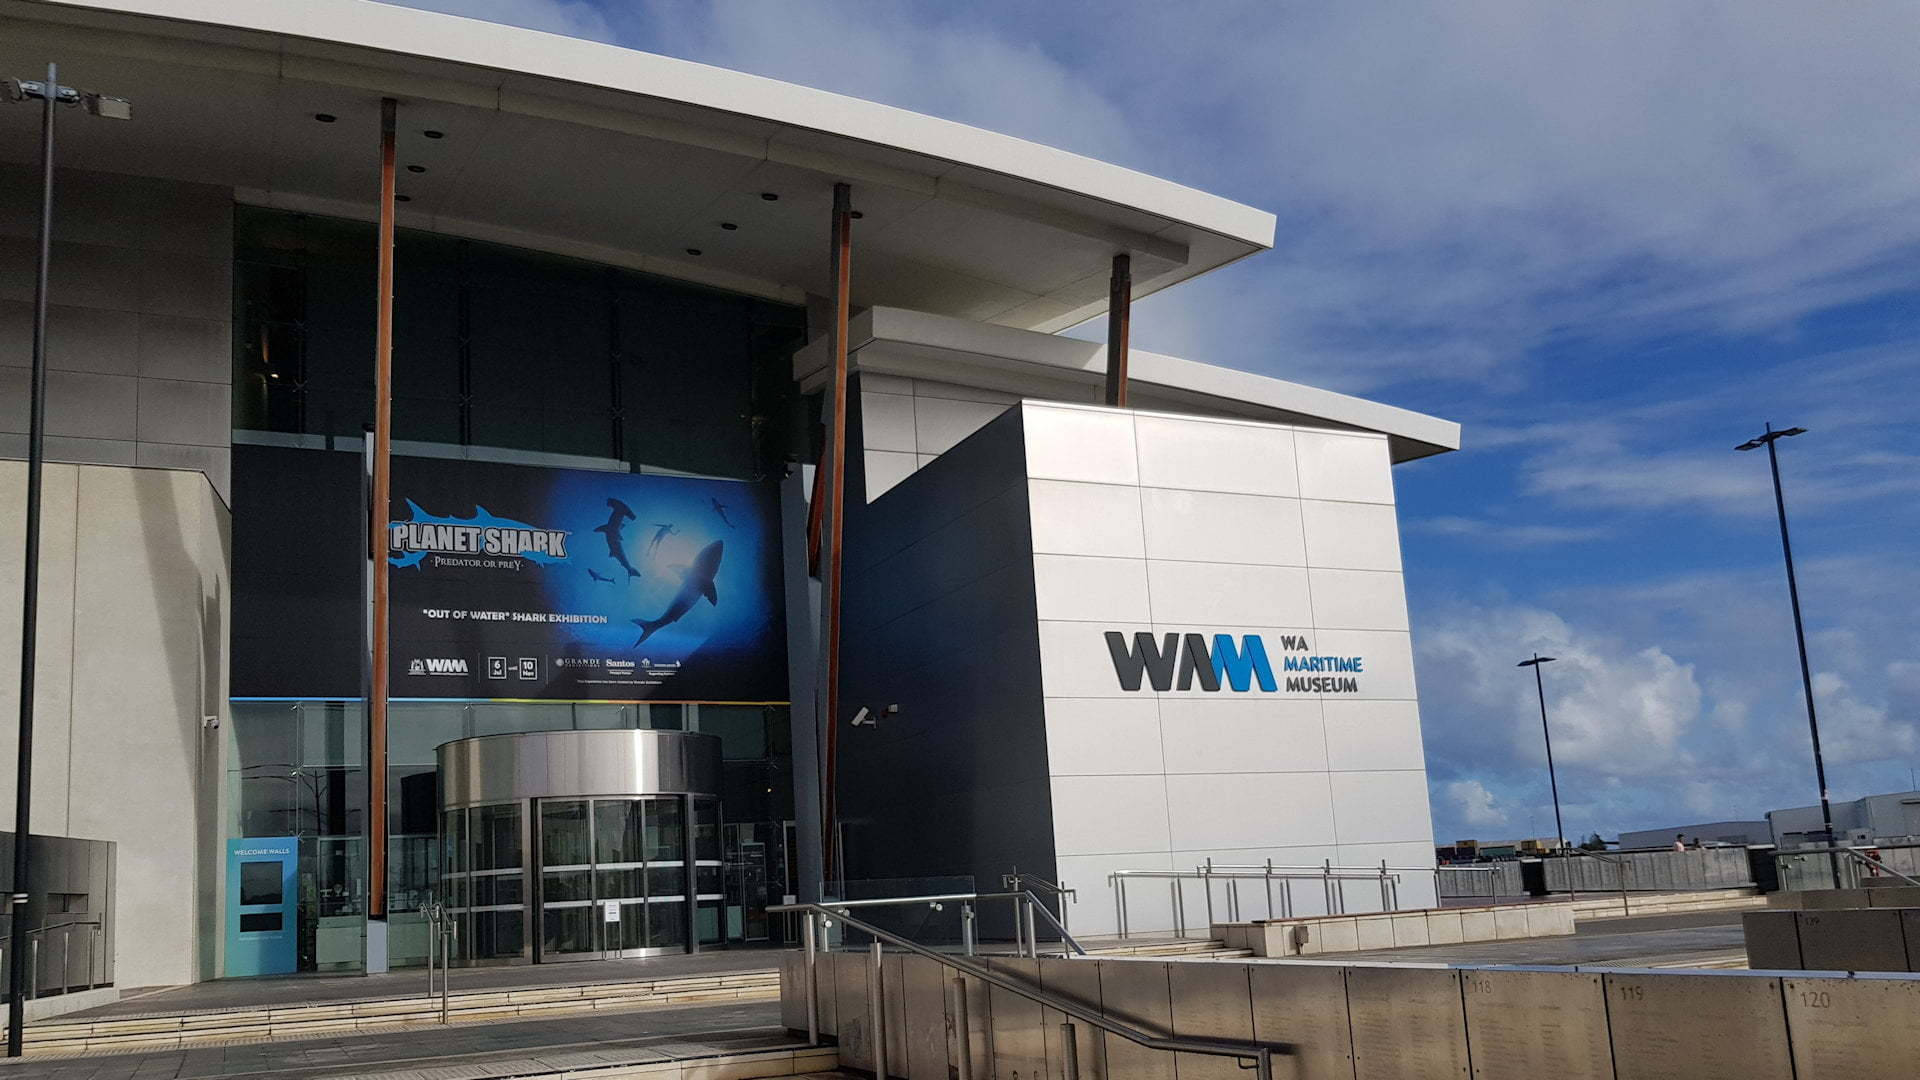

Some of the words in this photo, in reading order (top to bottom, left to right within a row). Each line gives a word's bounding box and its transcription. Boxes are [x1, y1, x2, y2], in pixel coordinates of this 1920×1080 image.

[390, 521, 481, 554] PLANET
[484, 528, 567, 559] SHARK
[483, 559, 496, 569] OR
[453, 610, 468, 619] OF
[512, 613, 547, 622] SHARK
[549, 613, 608, 624] EXHIBITION
[1280, 635, 1309, 652] WA
[426, 658, 469, 673] WAM
[494, 660, 501, 670] 6
[523, 661, 534, 671] 10
[606, 659, 635, 667] Santos
[1104, 631, 1279, 692] WAM
[1283, 656, 1363, 673] MARITIME
[1286, 677, 1358, 693] MUSEUM
[233, 848, 267, 856] WELCOME
[1473, 980, 1492, 994] 118
[1620, 986, 1644, 1000] 119
[1801, 991, 1831, 1009] 120
